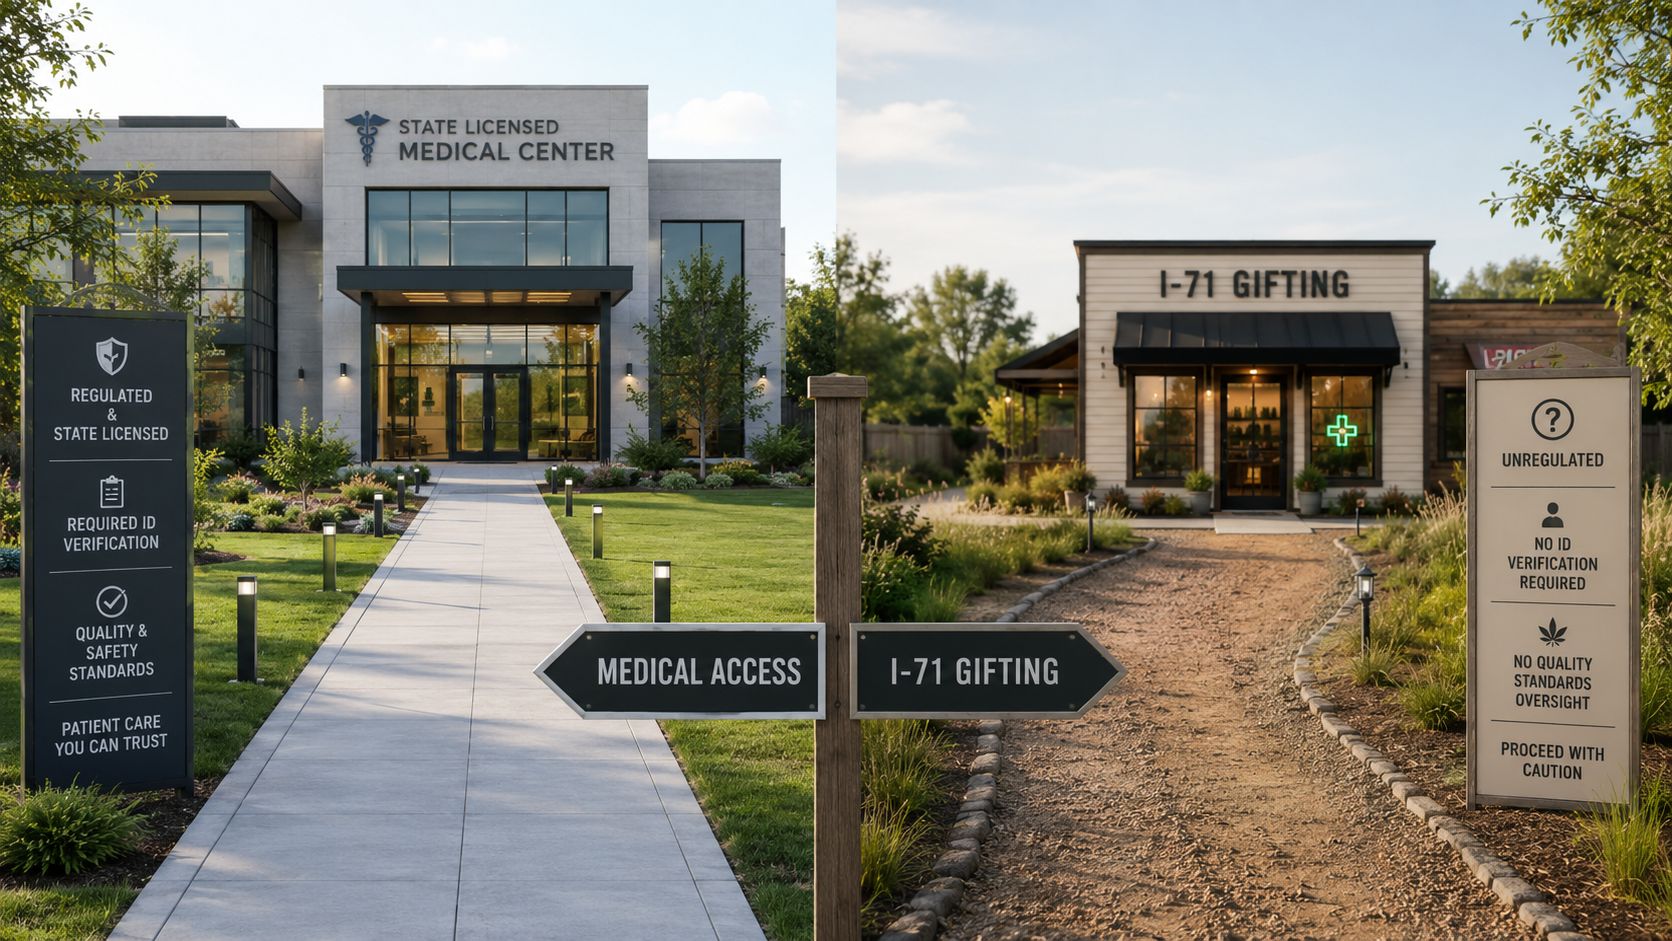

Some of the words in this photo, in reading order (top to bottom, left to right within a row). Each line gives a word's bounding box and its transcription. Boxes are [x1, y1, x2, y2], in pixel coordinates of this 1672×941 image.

[399, 119, 457, 135] STATE
[465, 119, 559, 135] LICENSED
[399, 141, 511, 162] MEDICAL
[518, 141, 615, 162] CENTER
[1160, 269, 1215, 299] I-71
[1232, 269, 1350, 299] GIFTING
[71, 387, 153, 403] REGULATED
[107, 407, 117, 422] &
[53, 426, 98, 441] STATE
[102, 426, 169, 441] LICENSED
[1502, 452, 1604, 468] UNREGULATED
[67, 515, 138, 533] REQUIRED
[142, 515, 156, 530] ID
[63, 534, 159, 552] VERIFICATION
[1534, 536, 1553, 551] NO
[1558, 537, 1571, 552] ID
[1507, 555, 1598, 572] VERIFICATION
[1519, 575, 1586, 591] REQUIRED
[75, 623, 134, 642] QUALITY
[138, 623, 148, 638] &
[86, 643, 138, 660] SAFETY
[69, 661, 155, 681] STANDARDS
[598, 657, 703, 686] MEDICAL
[710, 657, 802, 686] ACCESS
[891, 657, 941, 685] I-71
[956, 657, 1059, 686] GIFTING
[1513, 654, 1533, 669] NO
[1536, 655, 1593, 672] QUALITY
[1514, 673, 1592, 691] STANDARDS
[1515, 692, 1591, 710] OVERSIGHT
[62, 717, 121, 737] PATIENT
[124, 714, 161, 731] CARE
[55, 740, 84, 757] YOU
[89, 737, 119, 754] CAN
[122, 733, 168, 751] TRUST
[1501, 741, 1564, 759] PROCEED
[1568, 745, 1605, 762] WITH
[1522, 762, 1582, 780] CAUTION
